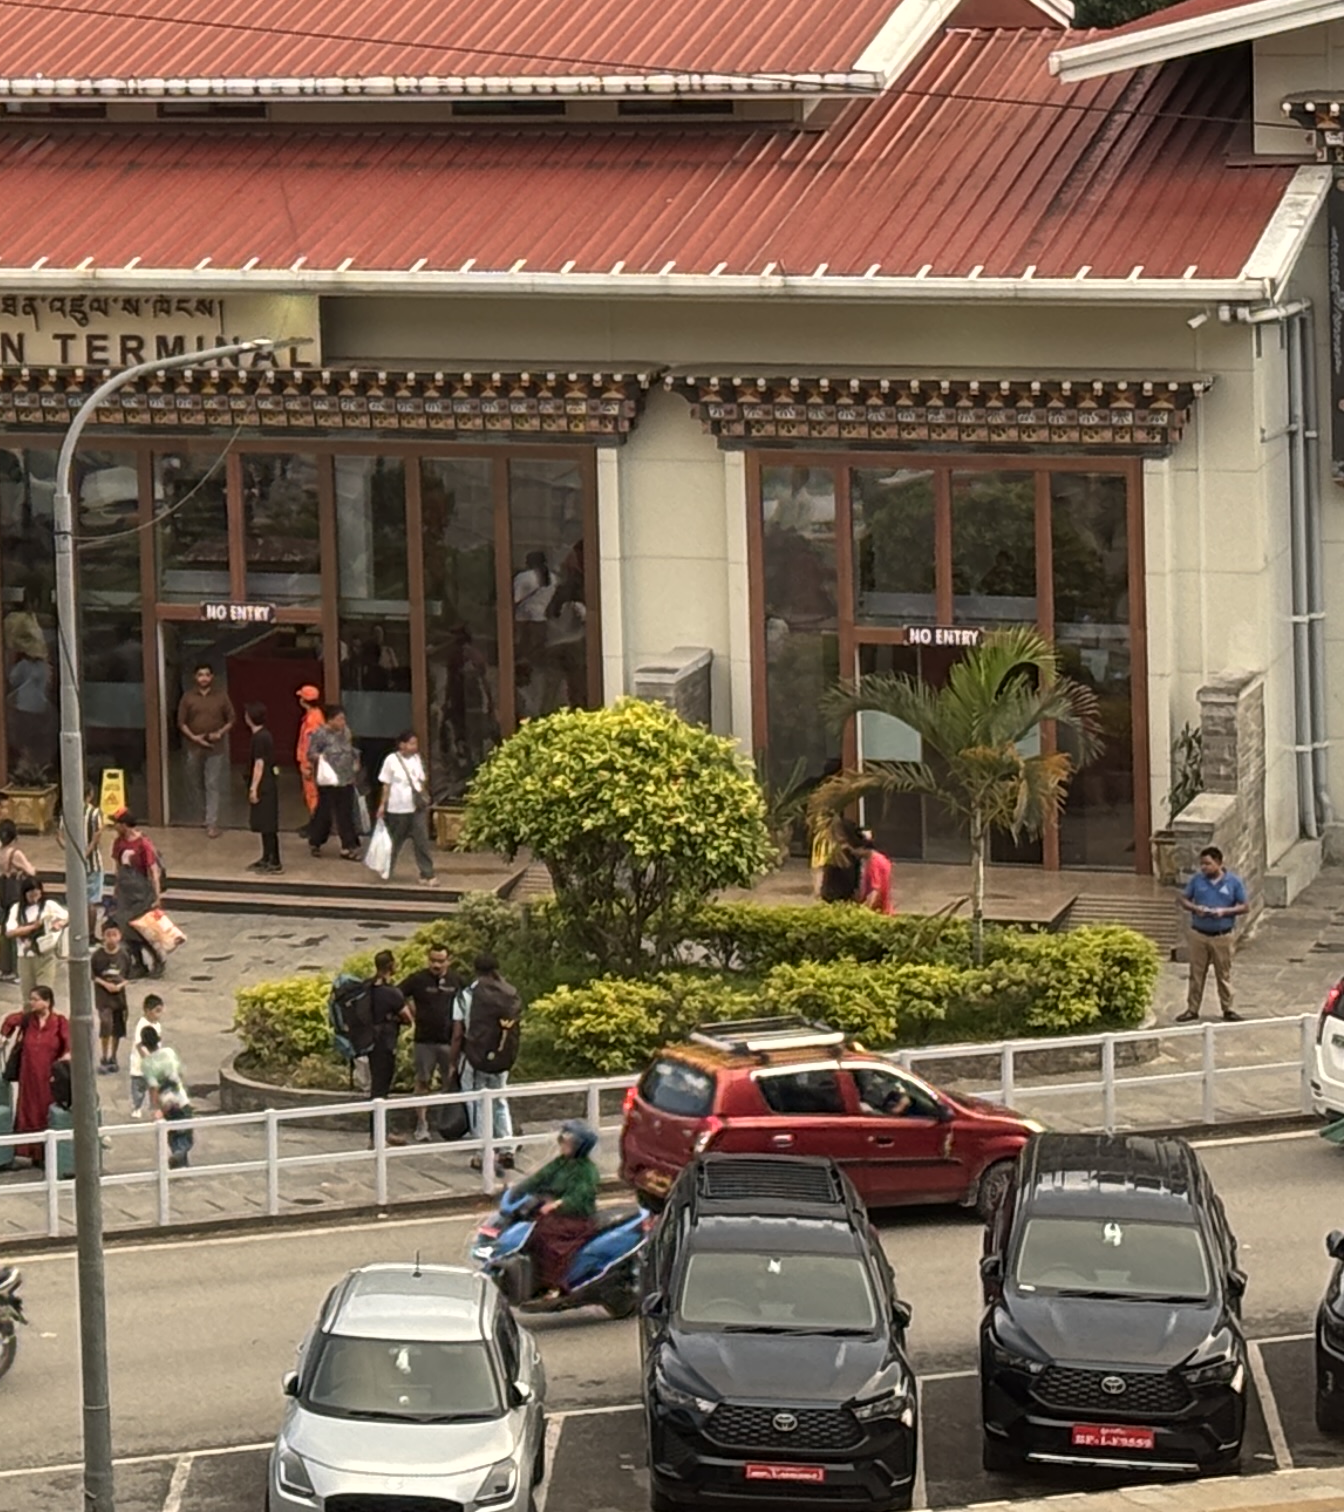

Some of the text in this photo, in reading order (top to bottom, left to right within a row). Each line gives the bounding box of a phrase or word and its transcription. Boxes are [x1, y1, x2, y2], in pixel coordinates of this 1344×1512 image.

[53, 332, 312, 368] TERMINAL
[206, 604, 270, 621] NO ENTRY
[909, 628, 978, 646] NO ENTRY
